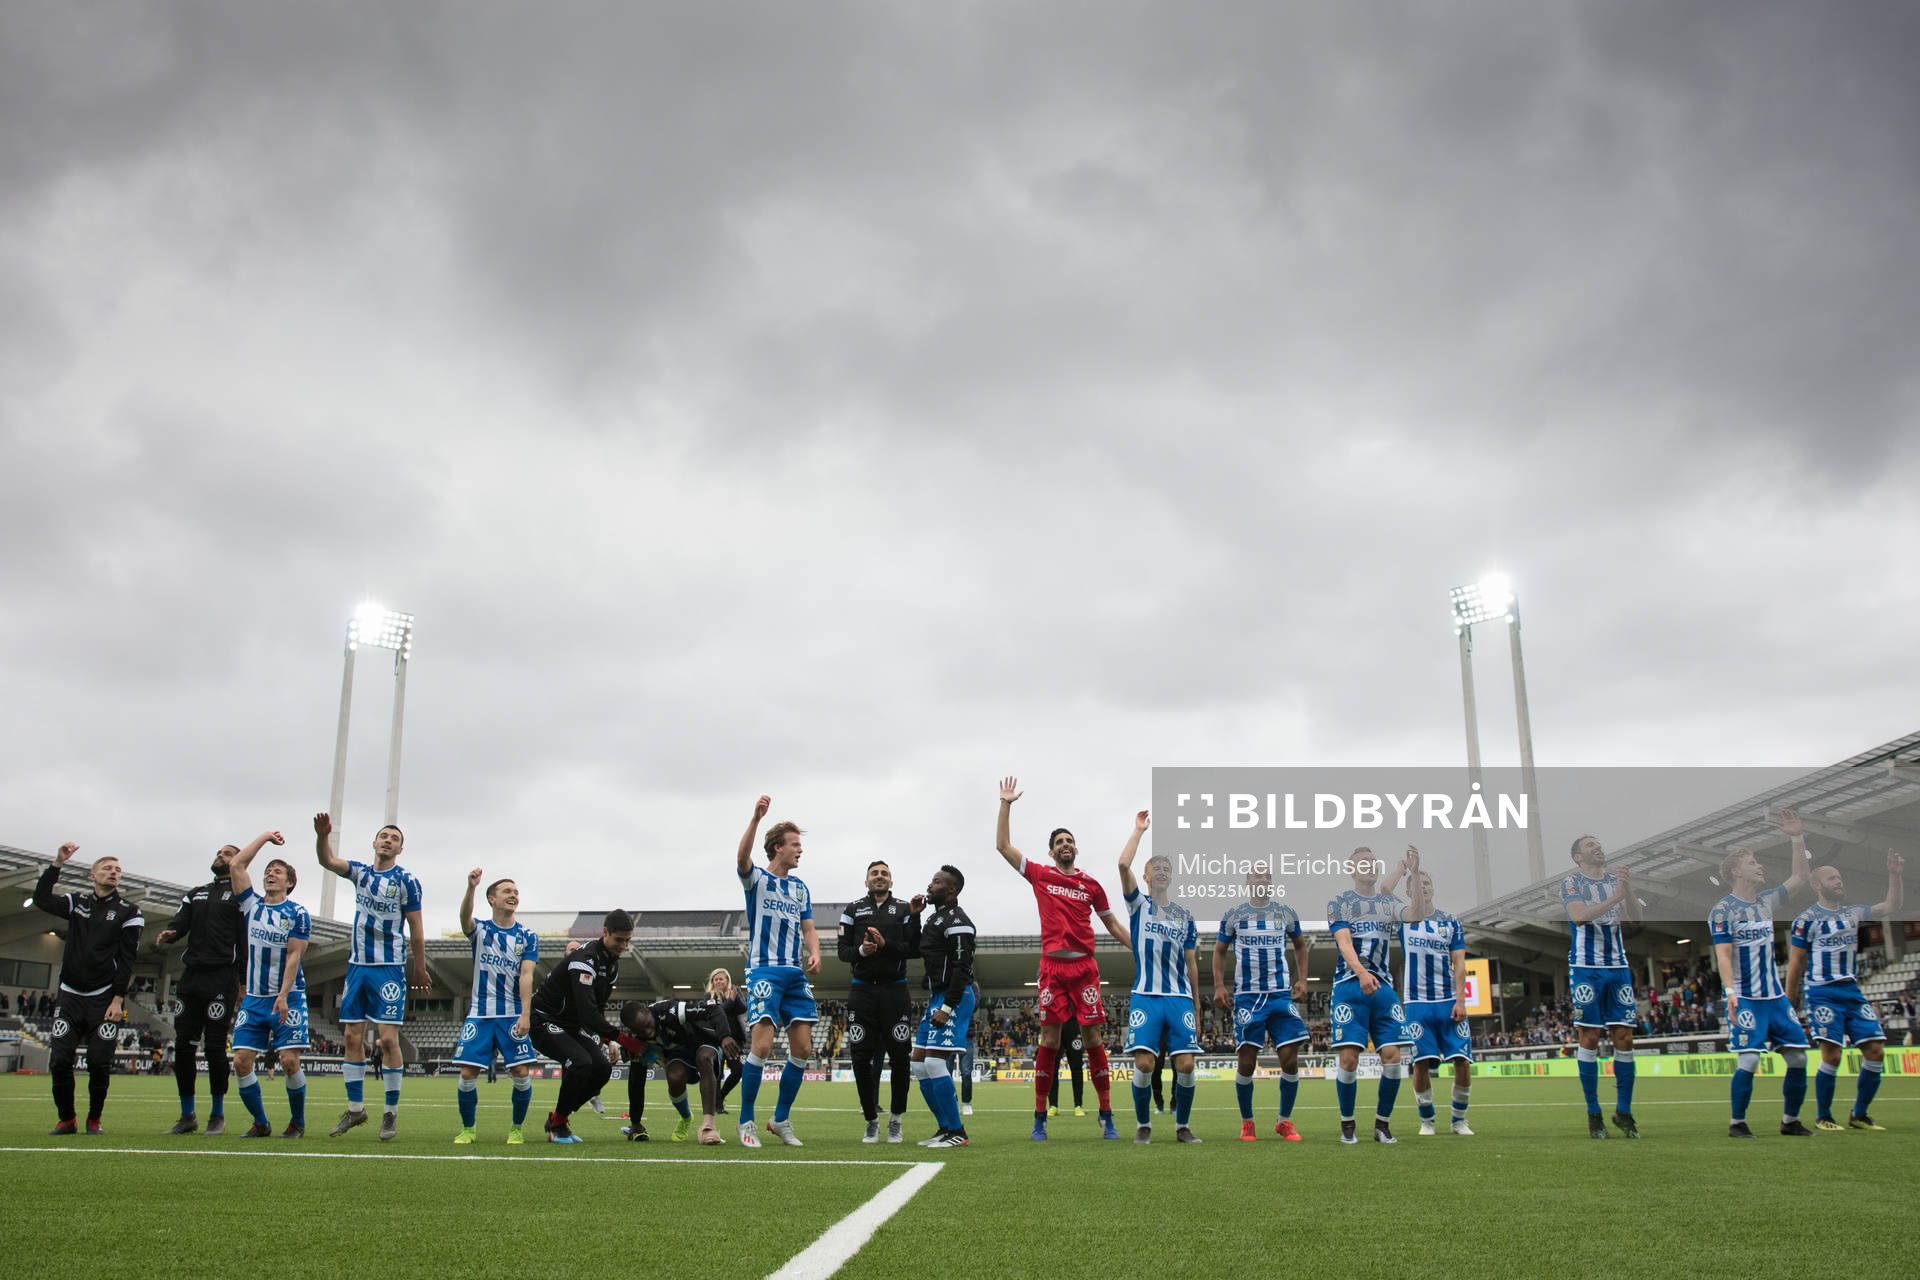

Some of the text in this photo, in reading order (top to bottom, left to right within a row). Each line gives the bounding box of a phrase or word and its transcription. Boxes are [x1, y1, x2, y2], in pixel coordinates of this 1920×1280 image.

[1046, 884, 1090, 901] SERNEKE
[762, 898, 800, 917] SERNEK
[251, 927, 288, 943] SERNEK
[1239, 935, 1283, 946] SERNEKE
[1408, 936, 1451, 951] SERNEK
[480, 952, 520, 971] SERNEK
[385, 1006, 397, 1015] 22
[517, 1044, 529, 1055] 10
